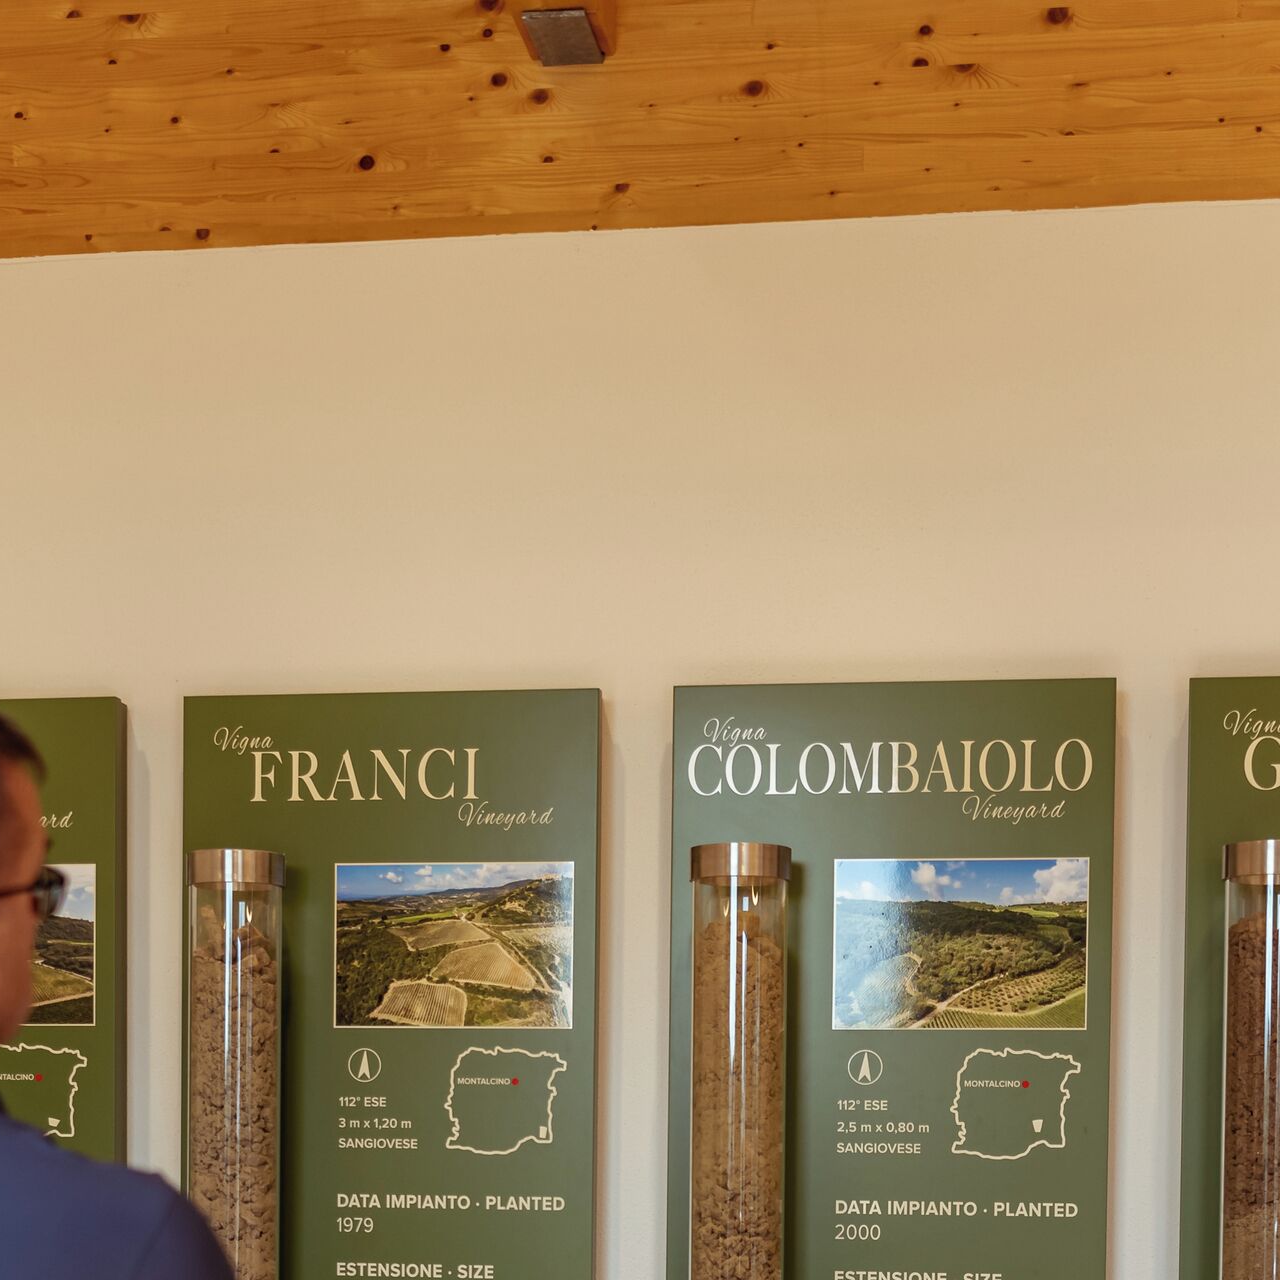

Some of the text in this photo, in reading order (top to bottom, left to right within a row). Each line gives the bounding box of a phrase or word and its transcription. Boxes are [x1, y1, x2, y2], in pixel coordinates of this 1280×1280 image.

[703, 716, 767, 748] Vigna
[213, 725, 274, 756] Vigna
[249, 748, 480, 801] FRANCI
[687, 738, 1093, 797] COLOMBAIOLO
[457, 801, 554, 830] Vineyard
[962, 794, 1066, 824] Vineyard
[364, 1097, 387, 1107] ESE
[864, 1100, 889, 1110] ESE
[373, 1118, 398, 1129] 1,20
[836, 1122, 915, 1134] 2,5 0,80
[338, 1138, 418, 1149] SANGIOVESE
[836, 1143, 921, 1153] SANGIOVESE
[337, 1194, 566, 1210] DATA IMPIANTO PLANTED
[835, 1200, 1079, 1217] DATA IMPIANTO PLANTED
[336, 1217, 374, 1232] 1979
[834, 1224, 881, 1240] 2000
[336, 1262, 494, 1279] ESTENSIONE SIZE
